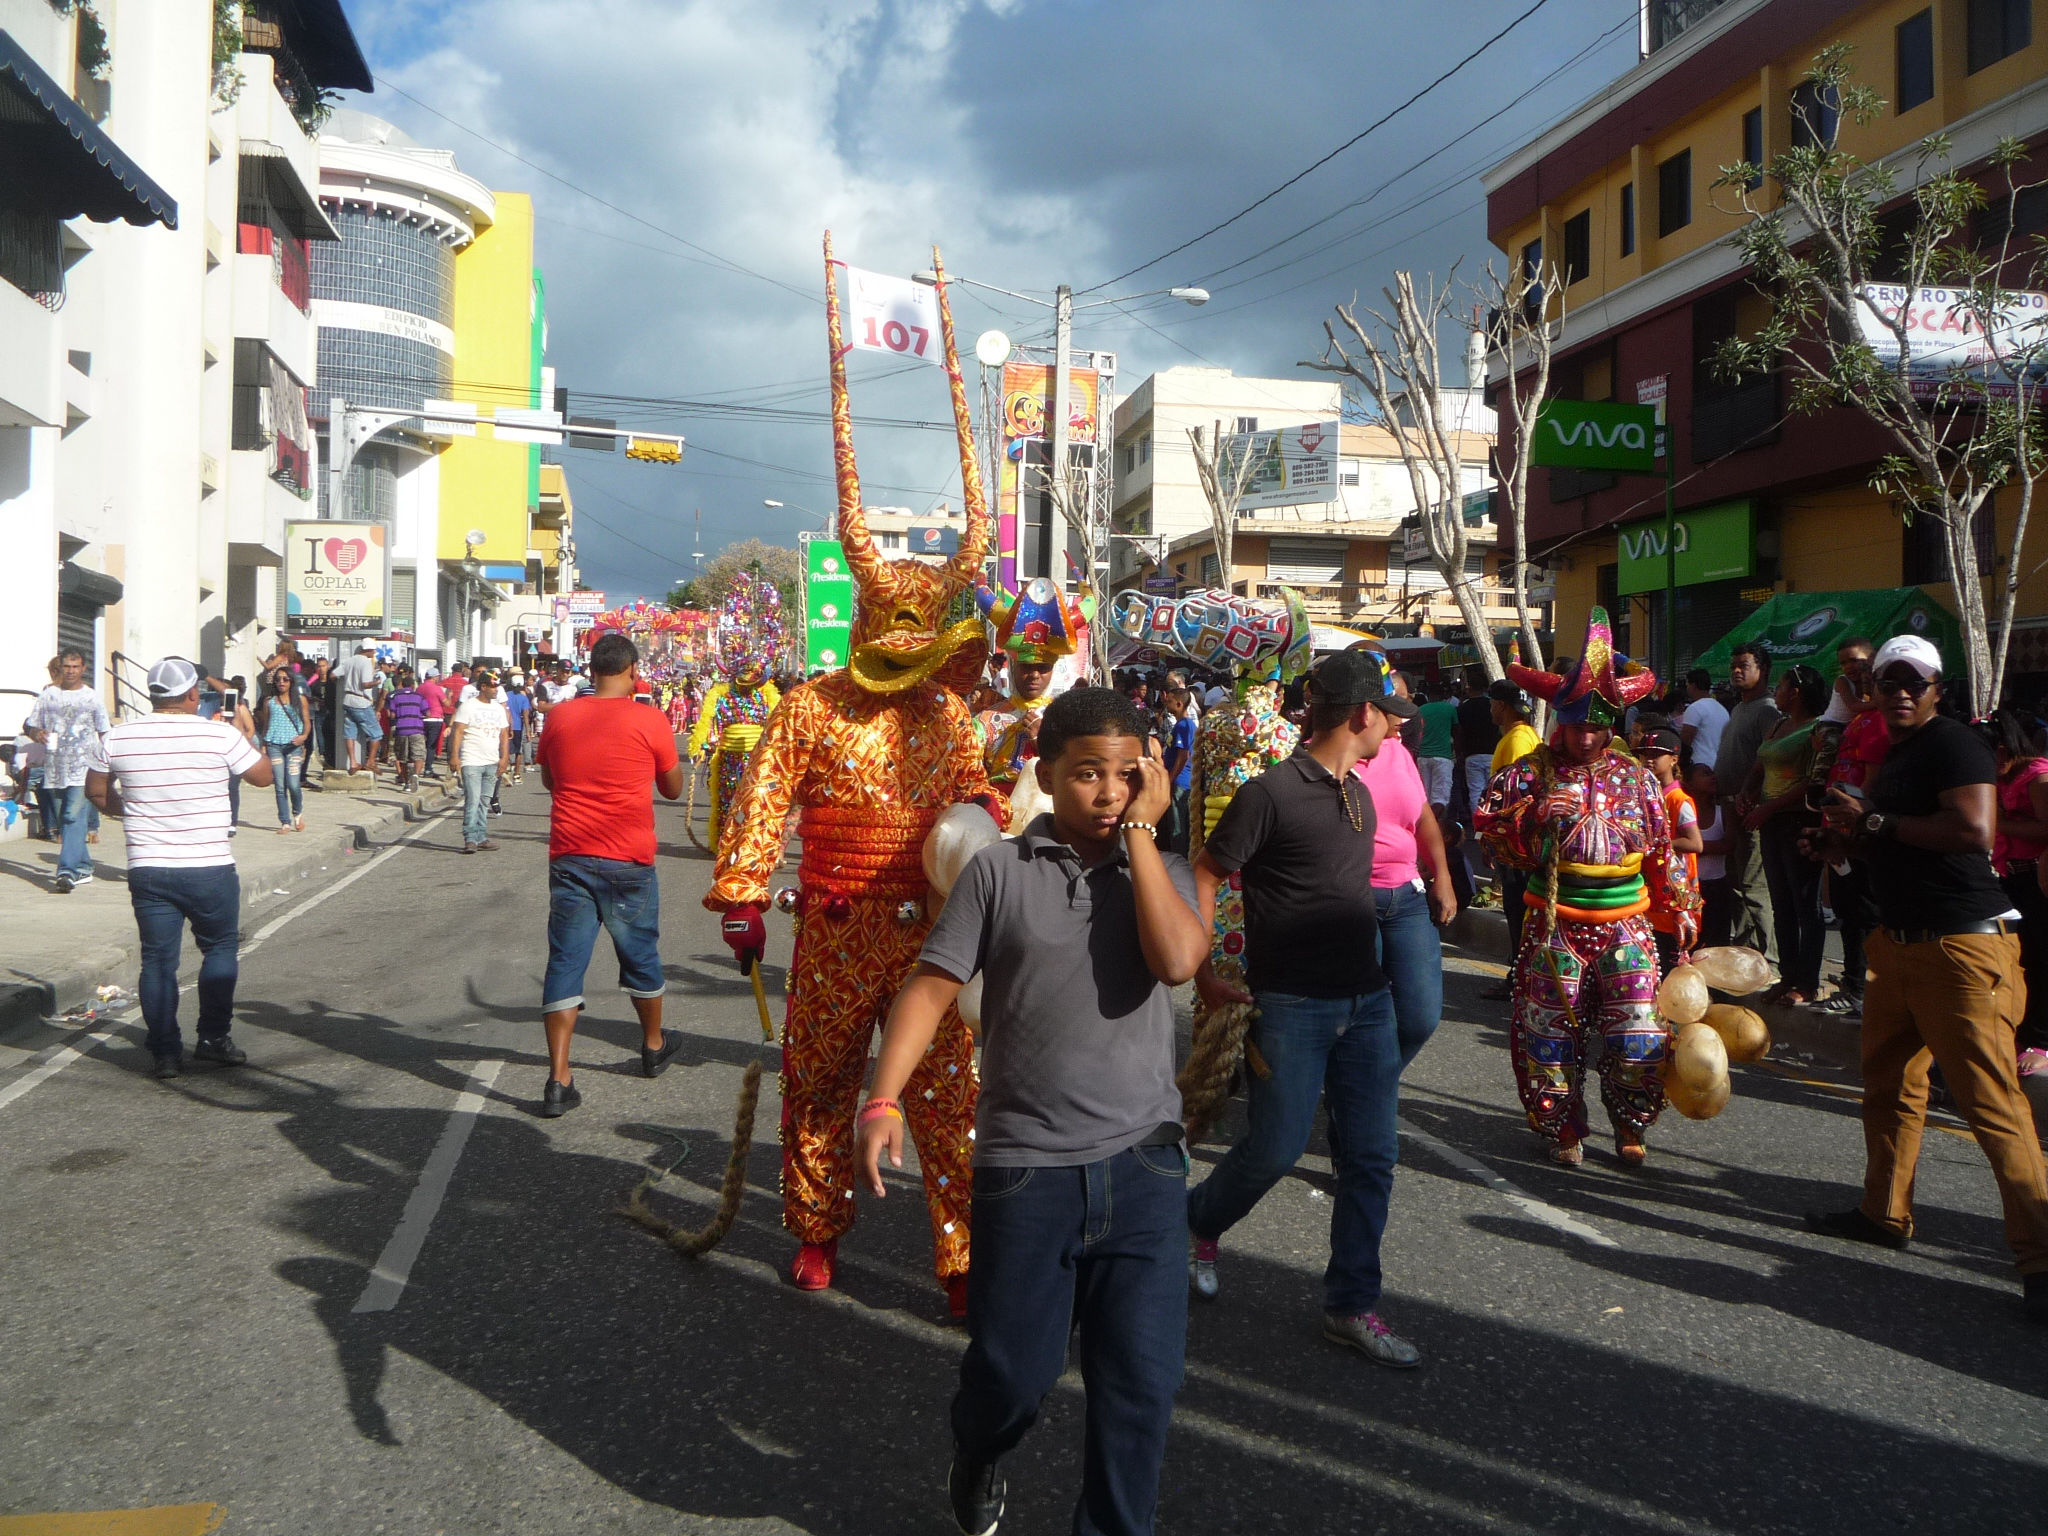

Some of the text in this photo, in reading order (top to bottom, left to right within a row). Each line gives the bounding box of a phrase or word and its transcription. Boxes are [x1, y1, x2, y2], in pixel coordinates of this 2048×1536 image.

[1865, 286, 1947, 303] CENRO
[384, 309, 428, 329] EDIFICIO
[404, 326, 442, 347] POLANCO
[863, 316, 929, 357] 107
[1867, 338, 1899, 347] otocopias
[304, 538, 323, 575] I
[304, 576, 367, 590] COPIAR
[811, 572, 851, 583] Presidente
[323, 599, 348, 607] COPY
[299, 618, 369, 627] T 809 338 6666
[809, 618, 850, 629] Presidente
